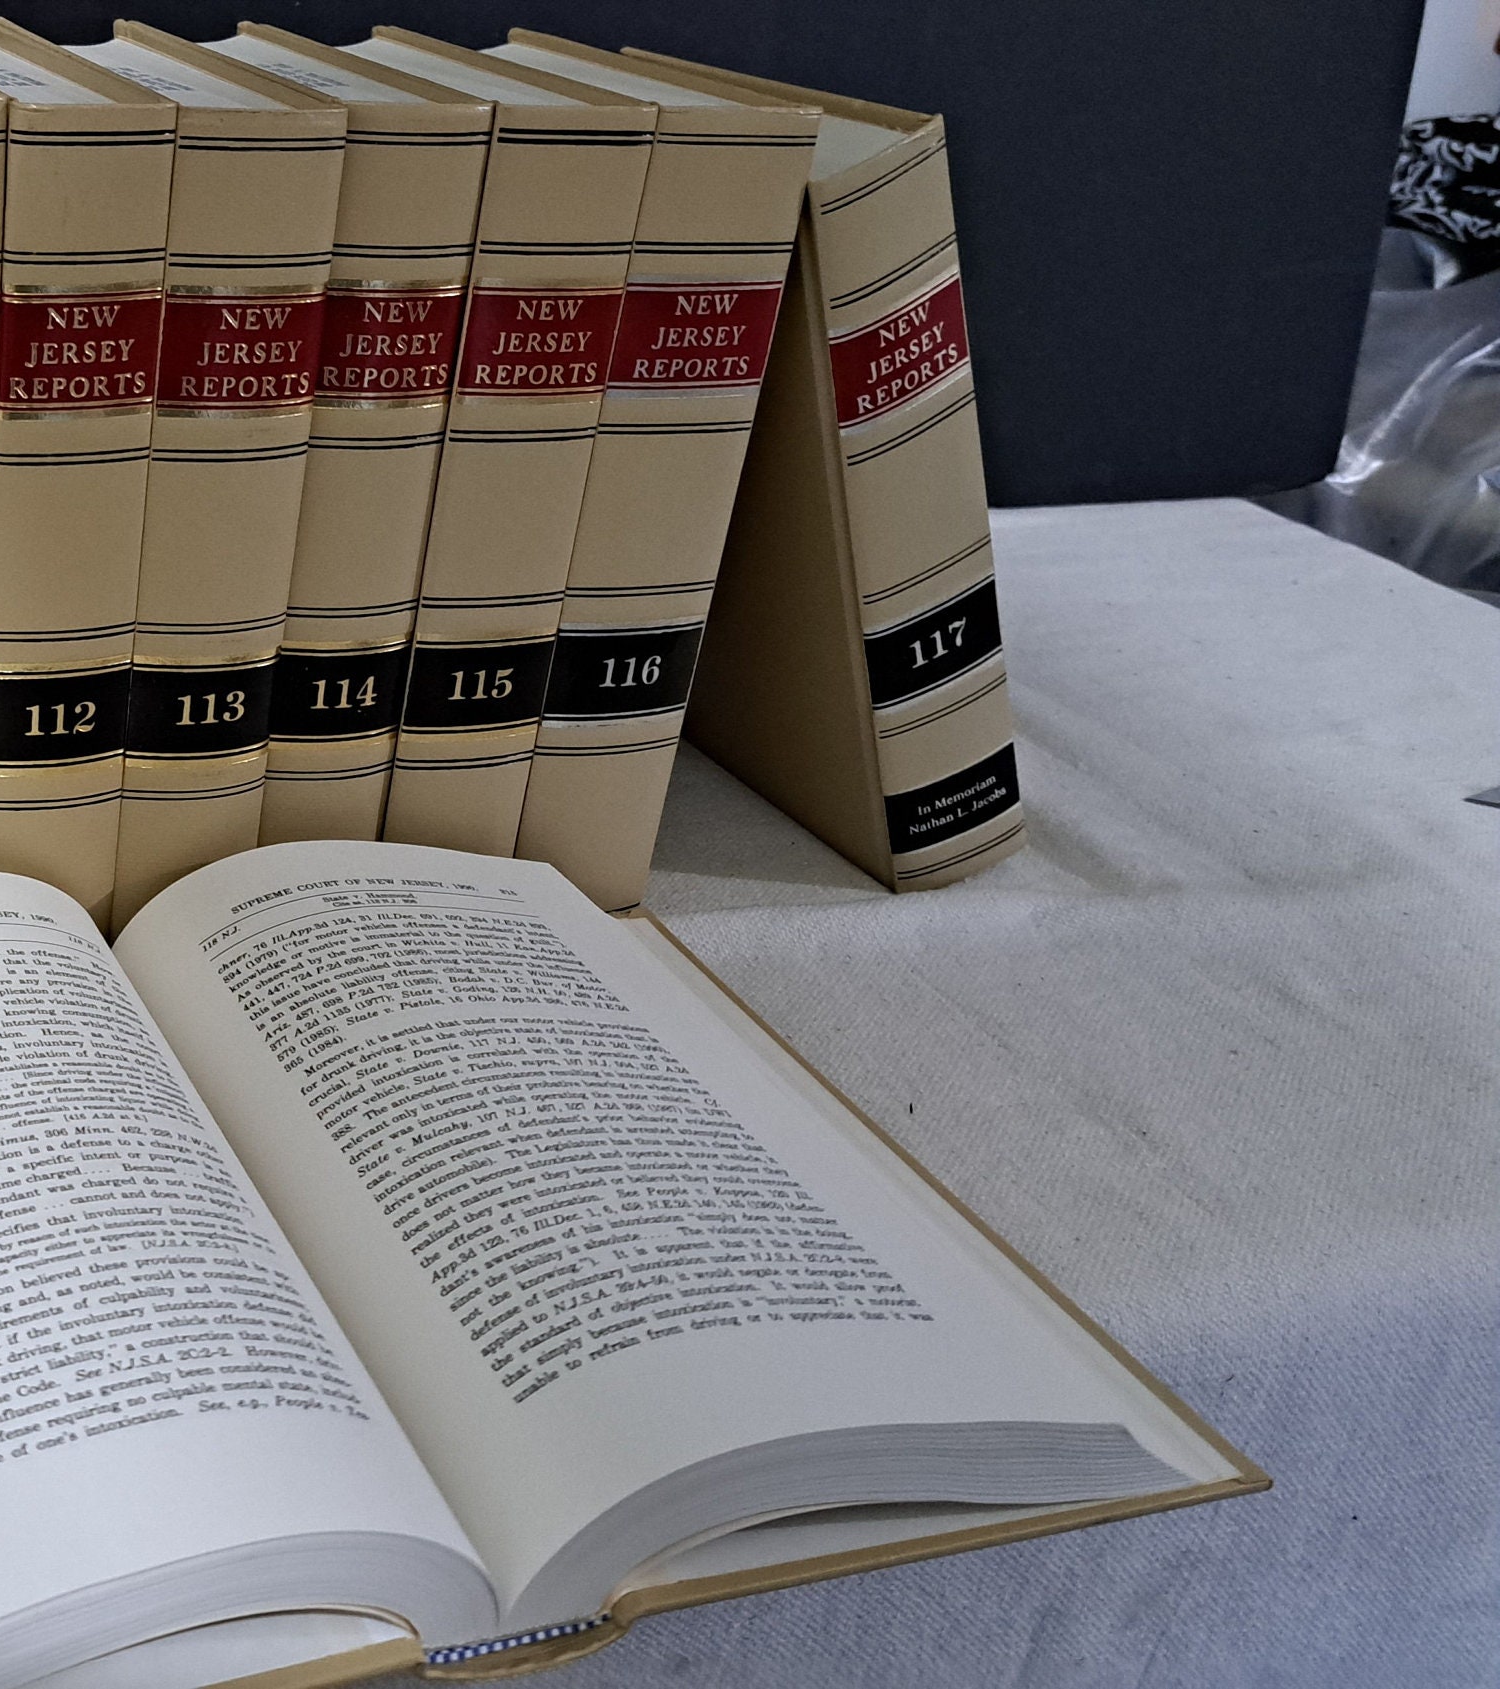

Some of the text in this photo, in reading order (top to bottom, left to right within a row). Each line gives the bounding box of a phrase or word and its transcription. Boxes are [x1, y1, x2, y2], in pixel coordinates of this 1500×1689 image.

[47, 305, 120, 330] NEW
[220, 307, 291, 330] NEW
[363, 301, 433, 323] NEW
[516, 300, 583, 320] NEW
[675, 294, 738, 315] NEW
[651, 326, 746, 350] JERSEY
[879, 301, 930, 348] NEW
[25, 339, 135, 368] JERSEY
[197, 340, 302, 366] JERSEY
[339, 333, 443, 357] JERSEY
[493, 331, 592, 355] JERSEY
[867, 322, 944, 384] JERSEY
[323, 363, 448, 388] REPORTS
[475, 363, 597, 385] REPORTS
[632, 356, 749, 378] REPORTS
[857, 343, 958, 414] REPORTS
[10, 372, 146, 399] REPORTS
[180, 372, 310, 397] REPORTS
[910, 617, 966, 668] 117
[449, 669, 513, 701] 115
[599, 655, 660, 687] 116
[175, 691, 245, 725] 113
[311, 676, 378, 710] 114
[25, 702, 96, 736] 112
[909, 813, 954, 835] Nathan
[972, 786, 1006, 812] Jacobs
[918, 776, 996, 816] In Memoriam
[231, 888, 293, 914] SUPREME
[297, 881, 339, 892] COURT
[401, 880, 449, 888] JERSEY,
[203, 938, 218, 952] 118
[218, 950, 251, 975] chner,
[253, 942, 268, 951] 76
[333, 917, 355, 926] 124,
[223, 970, 241, 984] 894
[245, 950, 279, 969] (1979)
[315, 928, 348, 940] motor
[354, 923, 397, 932] vehicles
[46, 970, 89, 981] element
[229, 940, 346, 993] knowledge or motive
[237, 942, 382, 1002] As observed by the court
[48, 980, 97, 991] provision
[304, 1023, 432, 1078] Moreover, it is settled
[301, 1043, 407, 1096] for drunk driving,
